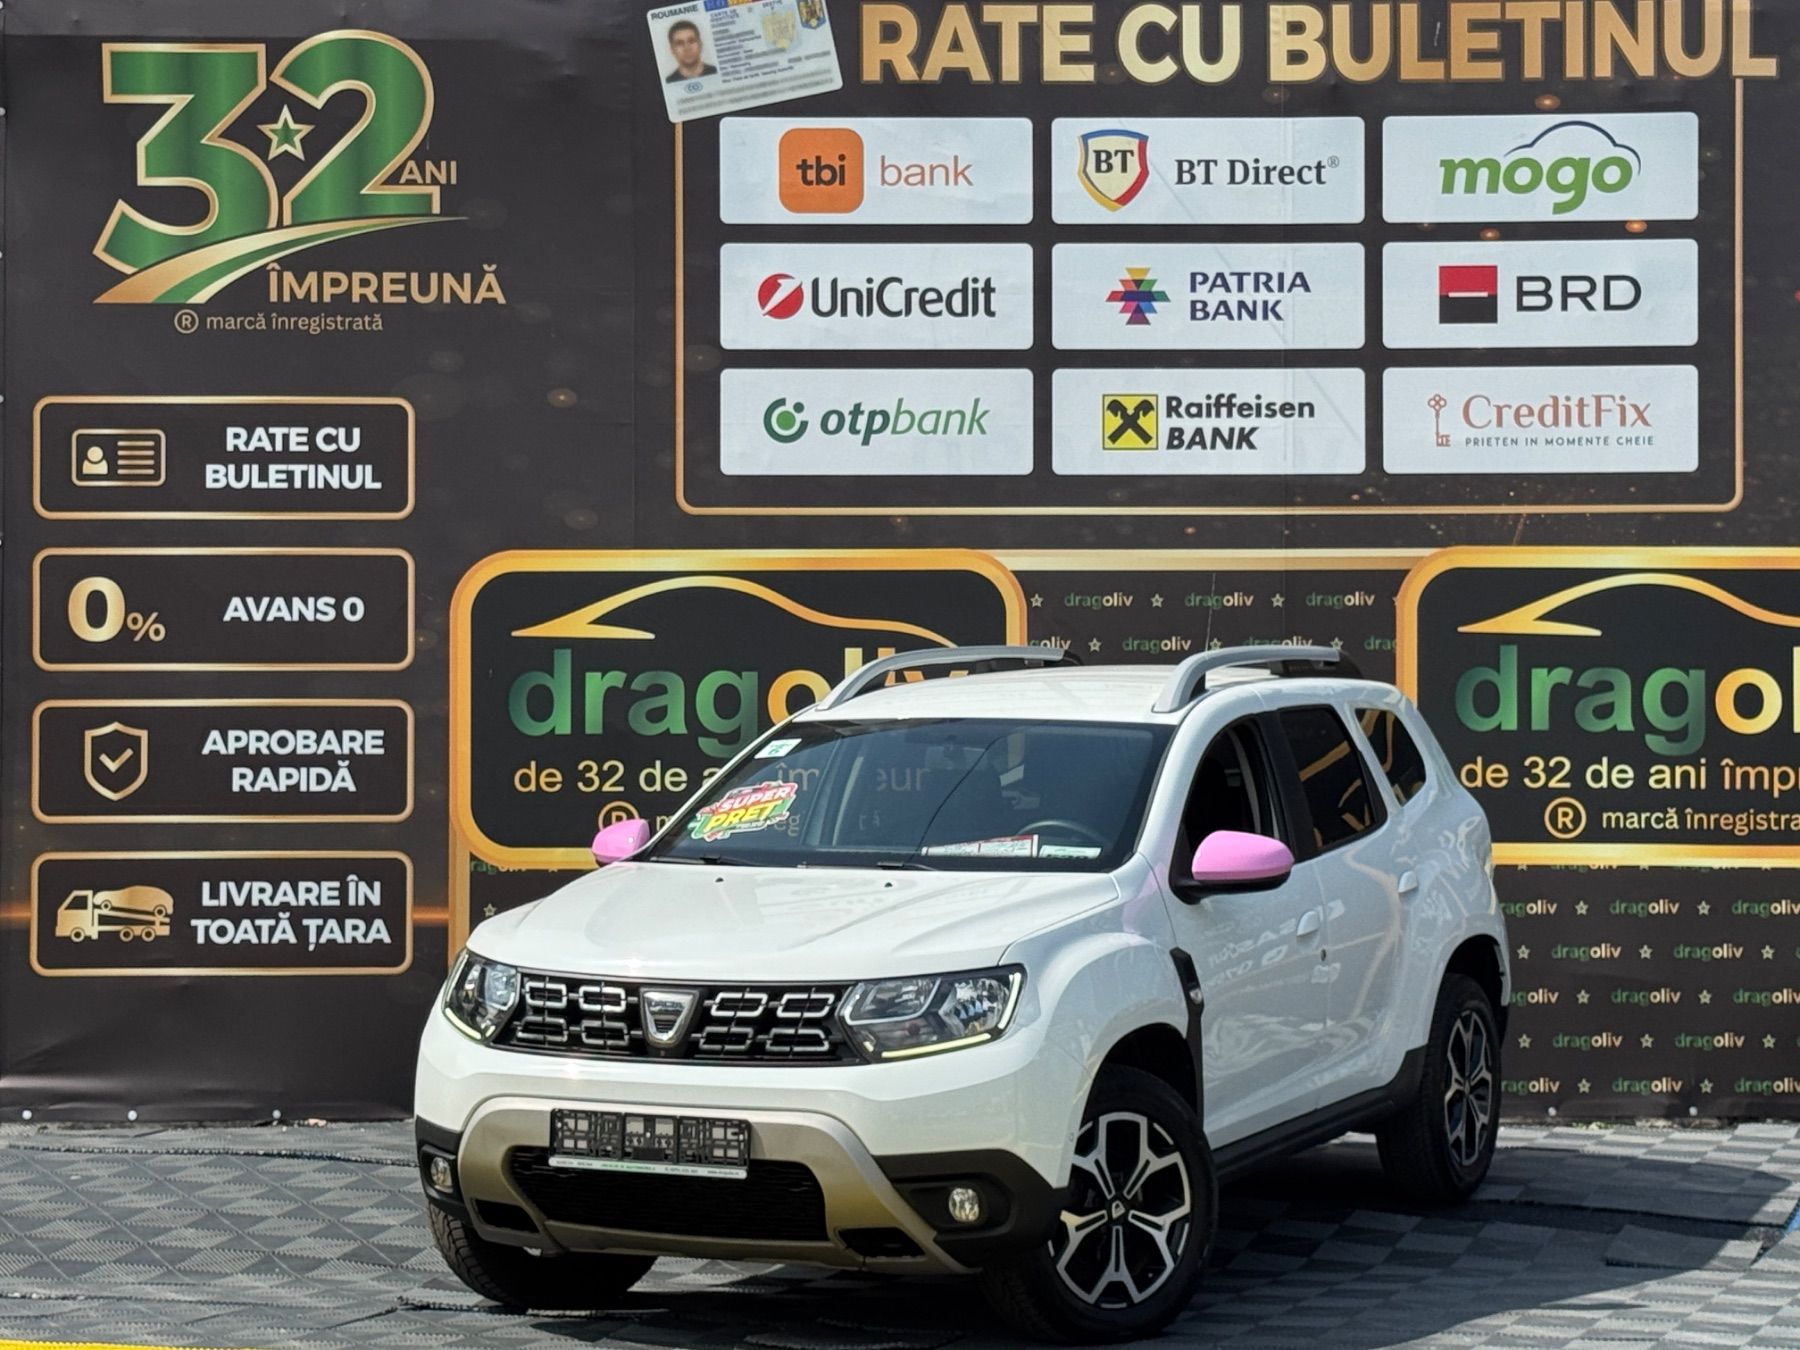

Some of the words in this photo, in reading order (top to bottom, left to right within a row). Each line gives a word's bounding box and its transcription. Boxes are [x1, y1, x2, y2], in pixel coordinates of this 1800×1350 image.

[859, 3, 1097, 85] RATE
[1116, 3, 1243, 85] CU
[1267, 0, 1780, 83] BULETINUL
[93, 29, 441, 275] 32
[1093, 149, 1135, 175] BT
[400, 160, 458, 185] ANI
[796, 155, 847, 187] tbi
[880, 155, 974, 187] bank
[1174, 159, 1218, 186] BT
[1439, 154, 1634, 215] mogo
[266, 262, 506, 304] ÎMPREUNĂ
[1189, 271, 1312, 294] PATRIA
[1515, 274, 1643, 312] BRD
[811, 276, 997, 319] UniCredit
[206, 313, 266, 331] marcă
[272, 313, 384, 335] înregistrată
[1189, 300, 1284, 322] BANK
[1165, 394, 1316, 420] Raiffeisen
[1462, 394, 1653, 430] CreditFix
[820, 397, 990, 446] otpbank
[226, 426, 309, 453] RATE
[316, 426, 361, 453] CU
[1166, 427, 1258, 450] BANK
[1465, 436, 1519, 447] PRIETEN
[1525, 436, 1538, 447] IN
[1545, 436, 1609, 447] MOMENTE
[1616, 436, 1654, 446] CHEIE
[205, 464, 382, 490] BULETINUL
[223, 597, 336, 623] AVANS
[343, 597, 365, 623] 0
[1064, 592, 1133, 610] dragoliv
[1185, 592, 1254, 610] dragoliv
[1306, 591, 1376, 610] dragoliv
[1122, 636, 1191, 654] dragoliv
[201, 730, 385, 755] APROBARE
[231, 762, 356, 793] RAPIDĂ
[514, 760, 563, 792] de
[577, 760, 625, 792] 32
[638, 760, 688, 792] de
[1460, 756, 1509, 788] de
[1523, 756, 1571, 788] 32
[1585, 757, 1634, 789] de
[1648, 757, 1707, 790] ani
[1720, 757, 1800, 798] împ
[720, 785, 793, 810] SUPER
[1602, 807, 1679, 830] marcă
[201, 882, 340, 908] LIVRARE
[347, 875, 382, 907] ÎN
[1609, 899, 1680, 917] dragoliv
[191, 911, 297, 944] TOATĂ
[303, 917, 391, 951] ȚARA
[1552, 943, 1621, 961] dragoliv
[1674, 943, 1744, 962] dragoliv
[1611, 988, 1681, 1006] dragoliv
[1552, 1032, 1622, 1051] dragoliv
[1675, 1032, 1745, 1051] dragoliv
[1612, 1077, 1682, 1095] dragoliv
